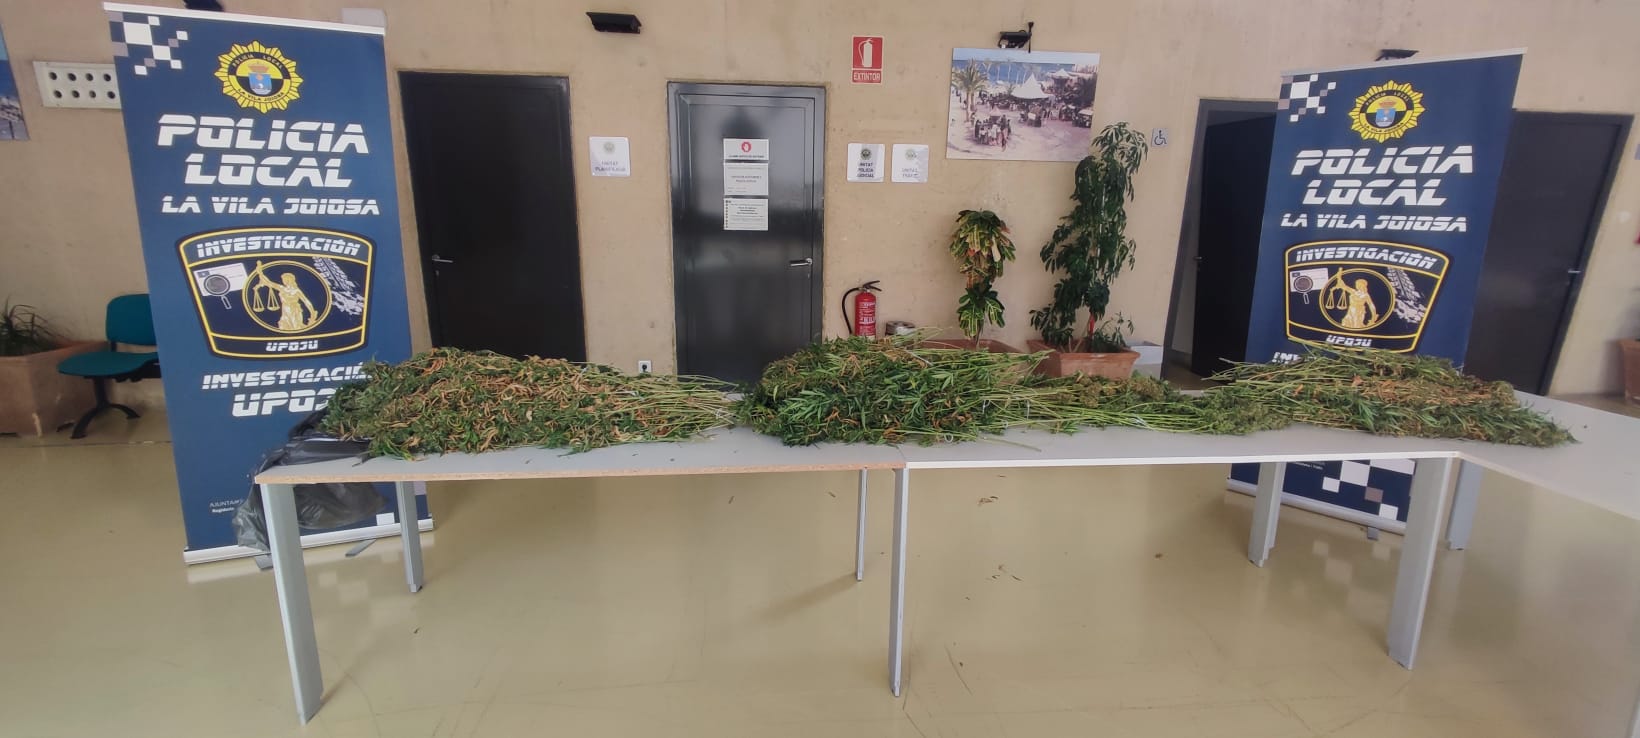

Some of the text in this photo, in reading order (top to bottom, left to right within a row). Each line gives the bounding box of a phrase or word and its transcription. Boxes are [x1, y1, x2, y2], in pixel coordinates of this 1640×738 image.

[853, 72, 881, 81] EXTINTOR
[157, 113, 369, 154] POLICIA
[184, 153, 352, 188] LOCAL
[1291, 145, 1473, 176] POLICIA
[1302, 178, 1447, 206] LOCAL
[161, 195, 380, 216] LA VILA JOIOSA
[1280, 213, 1467, 232] LA VILA JOIOSA
[197, 235, 361, 258] INVESTIGACIÓN
[1296, 246, 1437, 270] INVESTIGACIÓN
[265, 340, 319, 352] UPOJU
[1326, 334, 1373, 347] UPOJU
[202, 362, 373, 390] INVESTIGACIÓ
